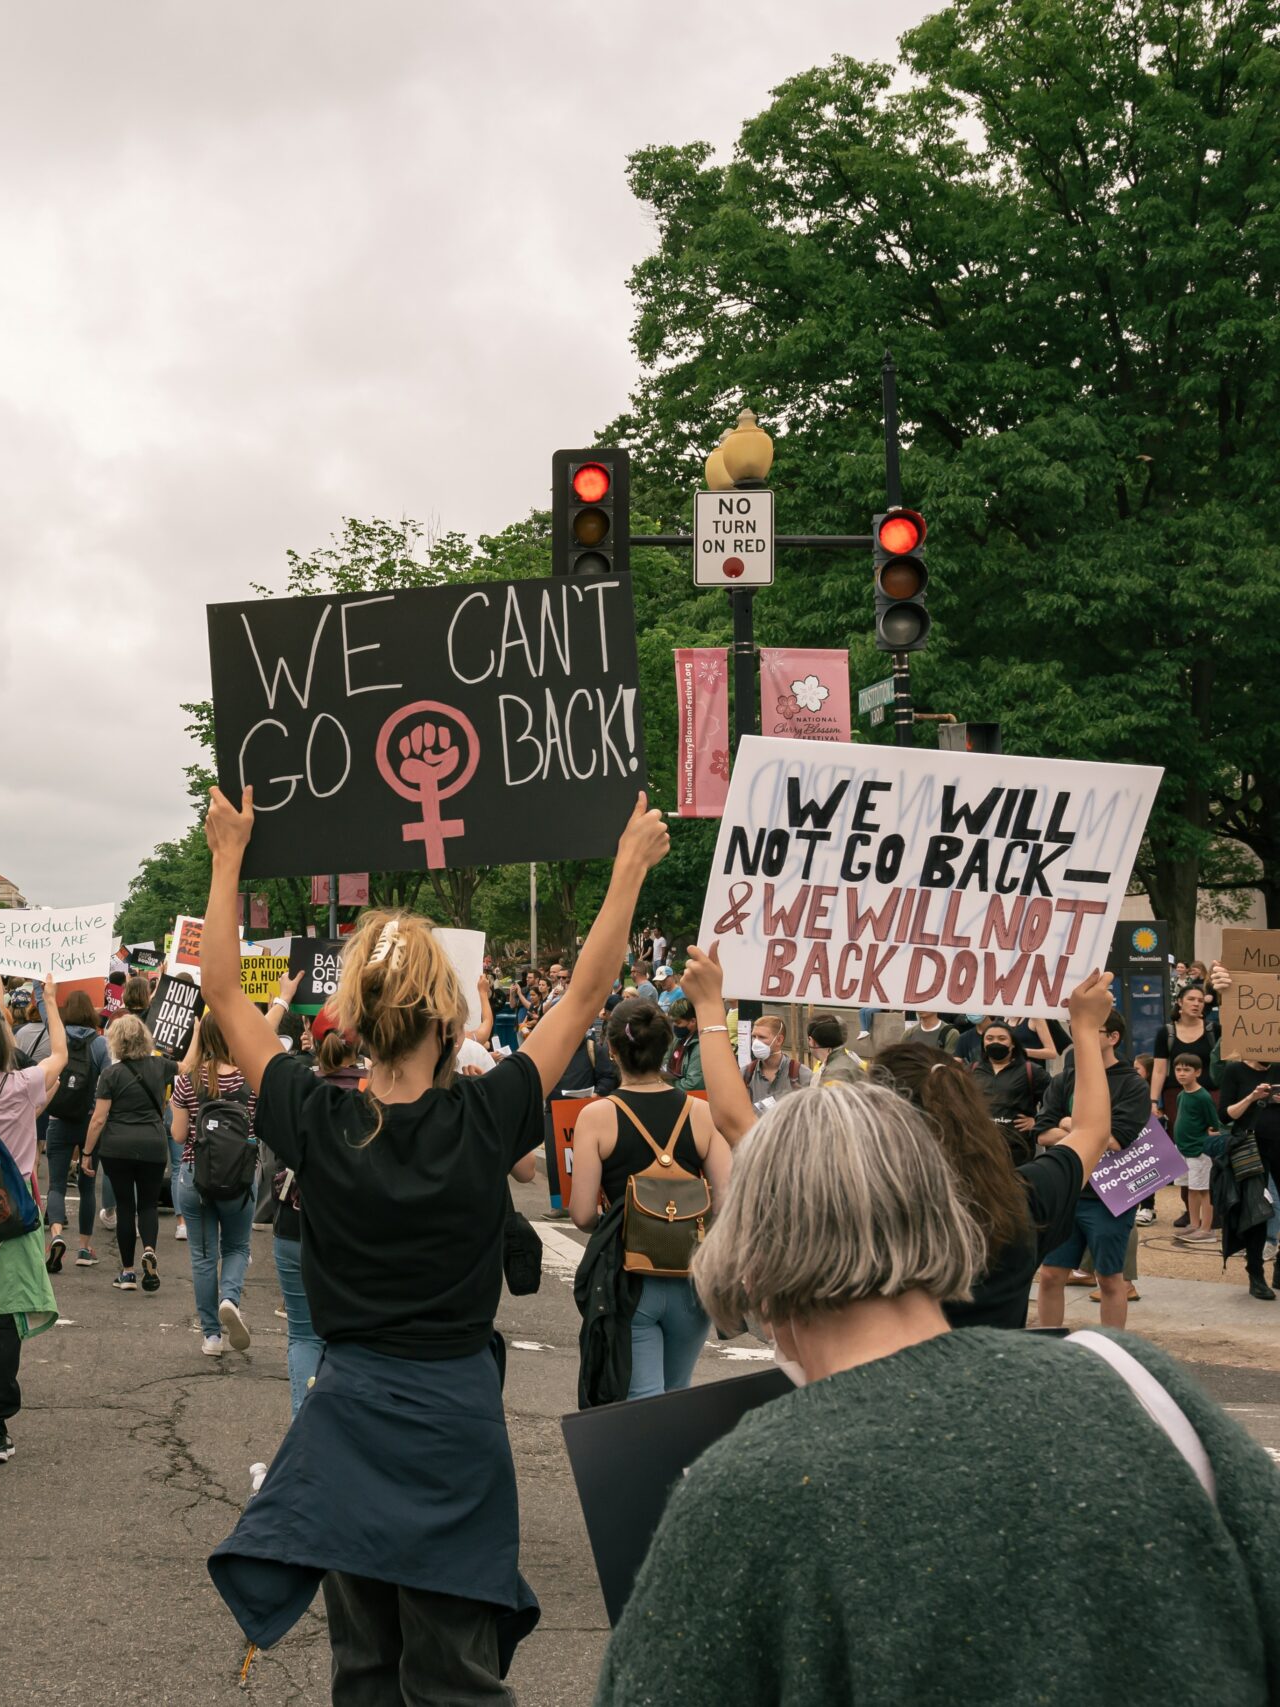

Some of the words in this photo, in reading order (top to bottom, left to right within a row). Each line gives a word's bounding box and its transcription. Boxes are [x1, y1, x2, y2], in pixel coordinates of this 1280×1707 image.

[719, 498, 751, 514] NO
[712, 520, 756, 534] TURN
[702, 539, 724, 553] ON
[734, 539, 765, 553] RED
[240, 595, 403, 709] WE
[447, 581, 620, 684] CAN'T
[685, 663, 694, 804] NationalCherryBlossomFestival.org
[773, 723, 803, 738] Cherry
[804, 723, 842, 734] Blossom
[238, 712, 351, 811] GO
[498, 684, 637, 786] BACK!
[787, 776, 892, 833] WE
[941, 785, 1076, 845] WILL
[723, 825, 832, 880] NOT
[840, 832, 906, 884] GO
[713, 880, 753, 935] &
[763, 882, 838, 939] WE
[847, 886, 971, 949] WILL
[978, 893, 1107, 956] NOT
[5, 936, 52, 950] RIGHTS
[61, 933, 89, 947] ARE
[51, 952, 96, 972] Rights
[760, 938, 900, 1002] BACK
[903, 946, 1071, 1009] DOWN.
[241, 982, 269, 994] IGHT
[251, 972, 257, 981] A
[312, 981, 340, 995] BO
[165, 980, 199, 1008] HOW
[158, 1000, 194, 1029] DARE
[152, 1019, 187, 1049] THEY.
[1091, 1142, 1154, 1181] Pro-Justice.
[1099, 1156, 1160, 1194] Pro-Choice.
[1136, 1171, 1157, 1186] NARAL
